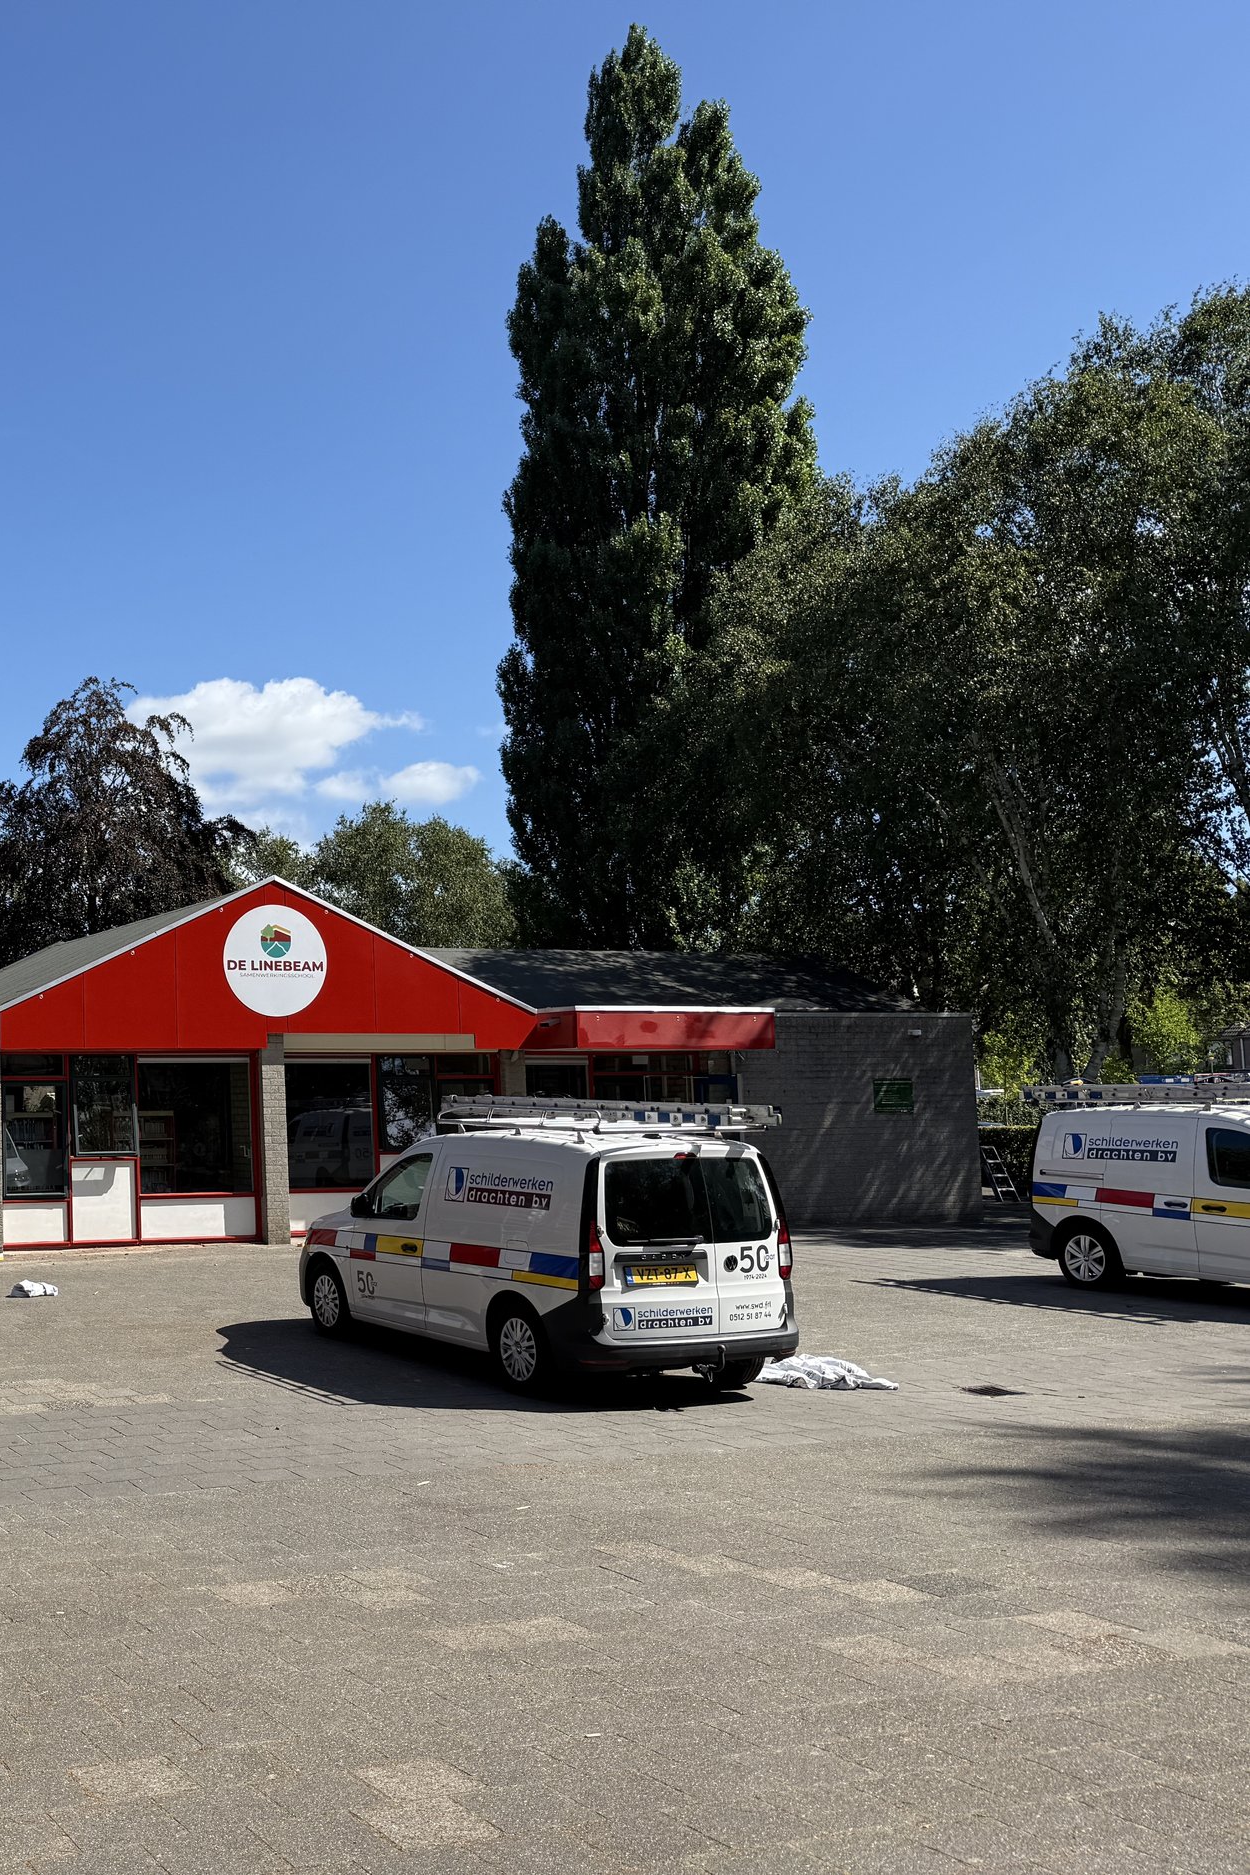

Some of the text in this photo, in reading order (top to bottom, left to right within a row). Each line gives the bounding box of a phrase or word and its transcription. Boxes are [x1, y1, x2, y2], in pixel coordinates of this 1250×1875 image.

[227, 960, 324, 972] DE LINEBEAM
[1088, 1136, 1179, 1150] schilderwerken
[1089, 1149, 1174, 1161] drachten bv
[469, 1172, 554, 1192] schilderwerken
[468, 1188, 548, 1208] drachten bv
[740, 1244, 770, 1273] 50
[636, 1267, 692, 1281] VZT-87-X
[357, 1270, 375, 1295] 50
[637, 1306, 713, 1319] schilderwerken
[729, 1313, 745, 1321] 0512
[746, 1312, 753, 1320] 51
[754, 1311, 763, 1320] 87
[639, 1316, 711, 1329] drachten bv
